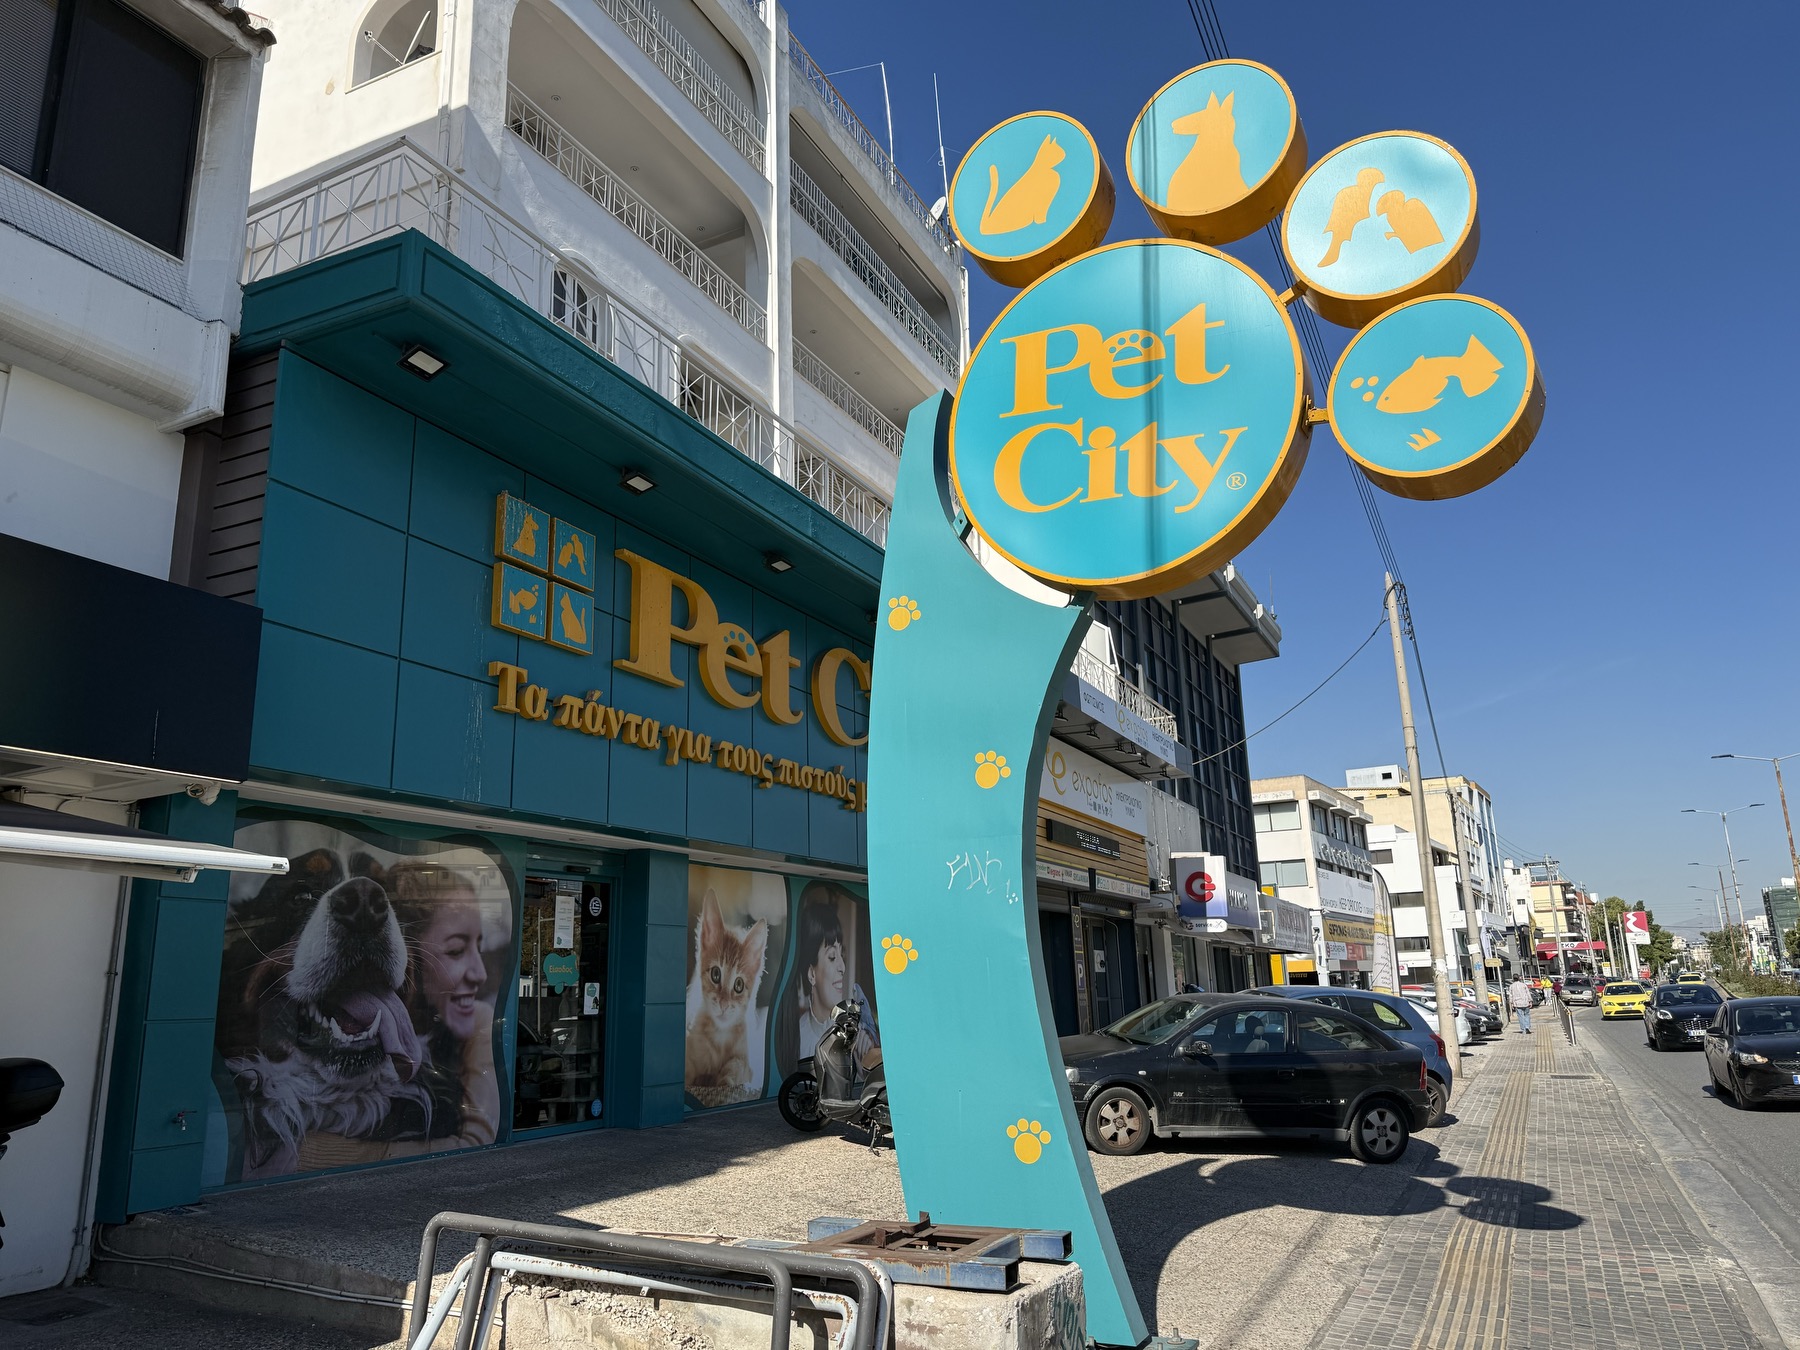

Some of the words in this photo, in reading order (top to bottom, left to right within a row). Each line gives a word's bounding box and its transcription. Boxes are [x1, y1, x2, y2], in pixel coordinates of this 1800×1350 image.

[999, 302, 1231, 418] Pet
[994, 417, 1248, 514] City
[613, 548, 804, 726] Pet
[488, 660, 549, 721] Τα
[552, 690, 661, 750] πάντα
[662, 723, 713, 766] για
[714, 741, 774, 789] τους
[774, 757, 858, 810] πιστούς
